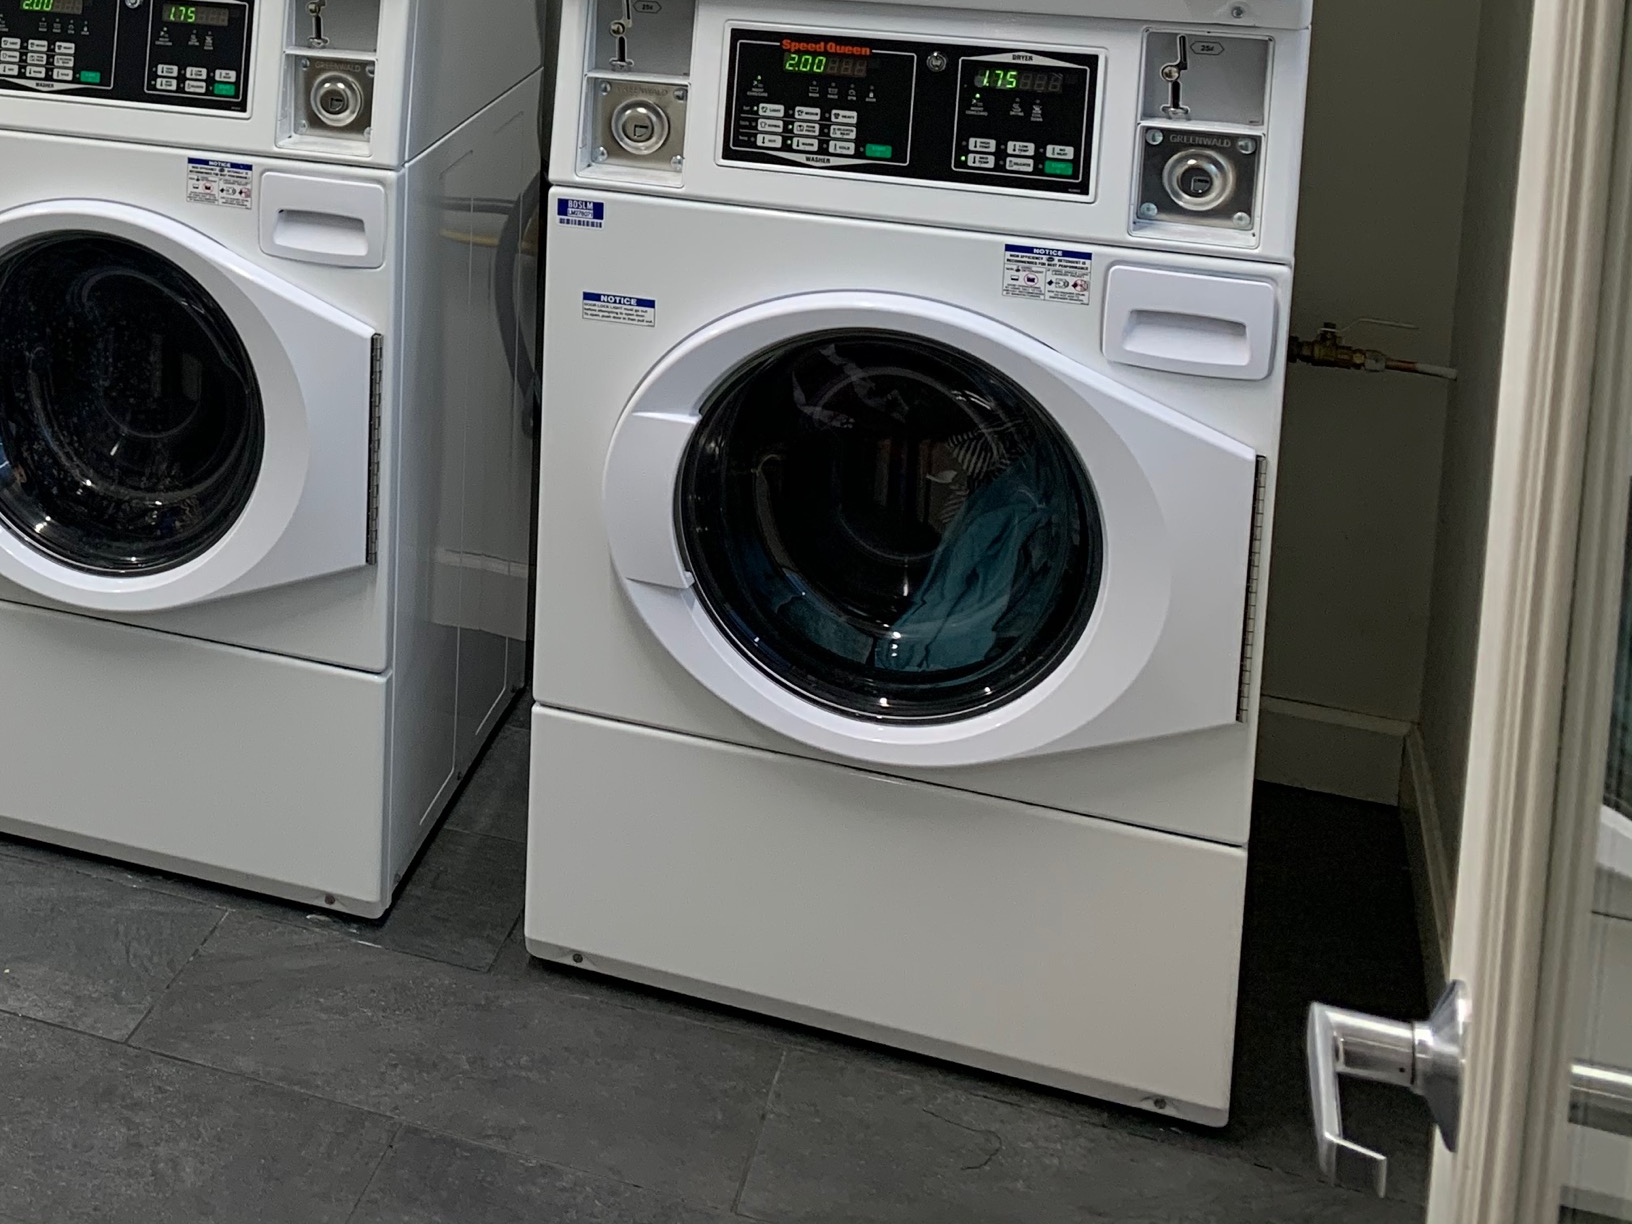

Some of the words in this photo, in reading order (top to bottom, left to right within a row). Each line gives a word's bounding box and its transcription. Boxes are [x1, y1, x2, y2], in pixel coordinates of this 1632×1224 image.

[169, 6, 196, 22] 1.75
[782, 39, 825, 52] Speed
[826, 42, 871, 55] Queen
[785, 54, 826, 72] 2.00
[983, 70, 1017, 88] 1.75
[1170, 134, 1231, 147] GREENWALD
[805, 156, 831, 164] WASHER
[568, 200, 593, 210] BDSLM
[1033, 248, 1063, 256] NOTICE
[600, 295, 637, 305] NOTICE
